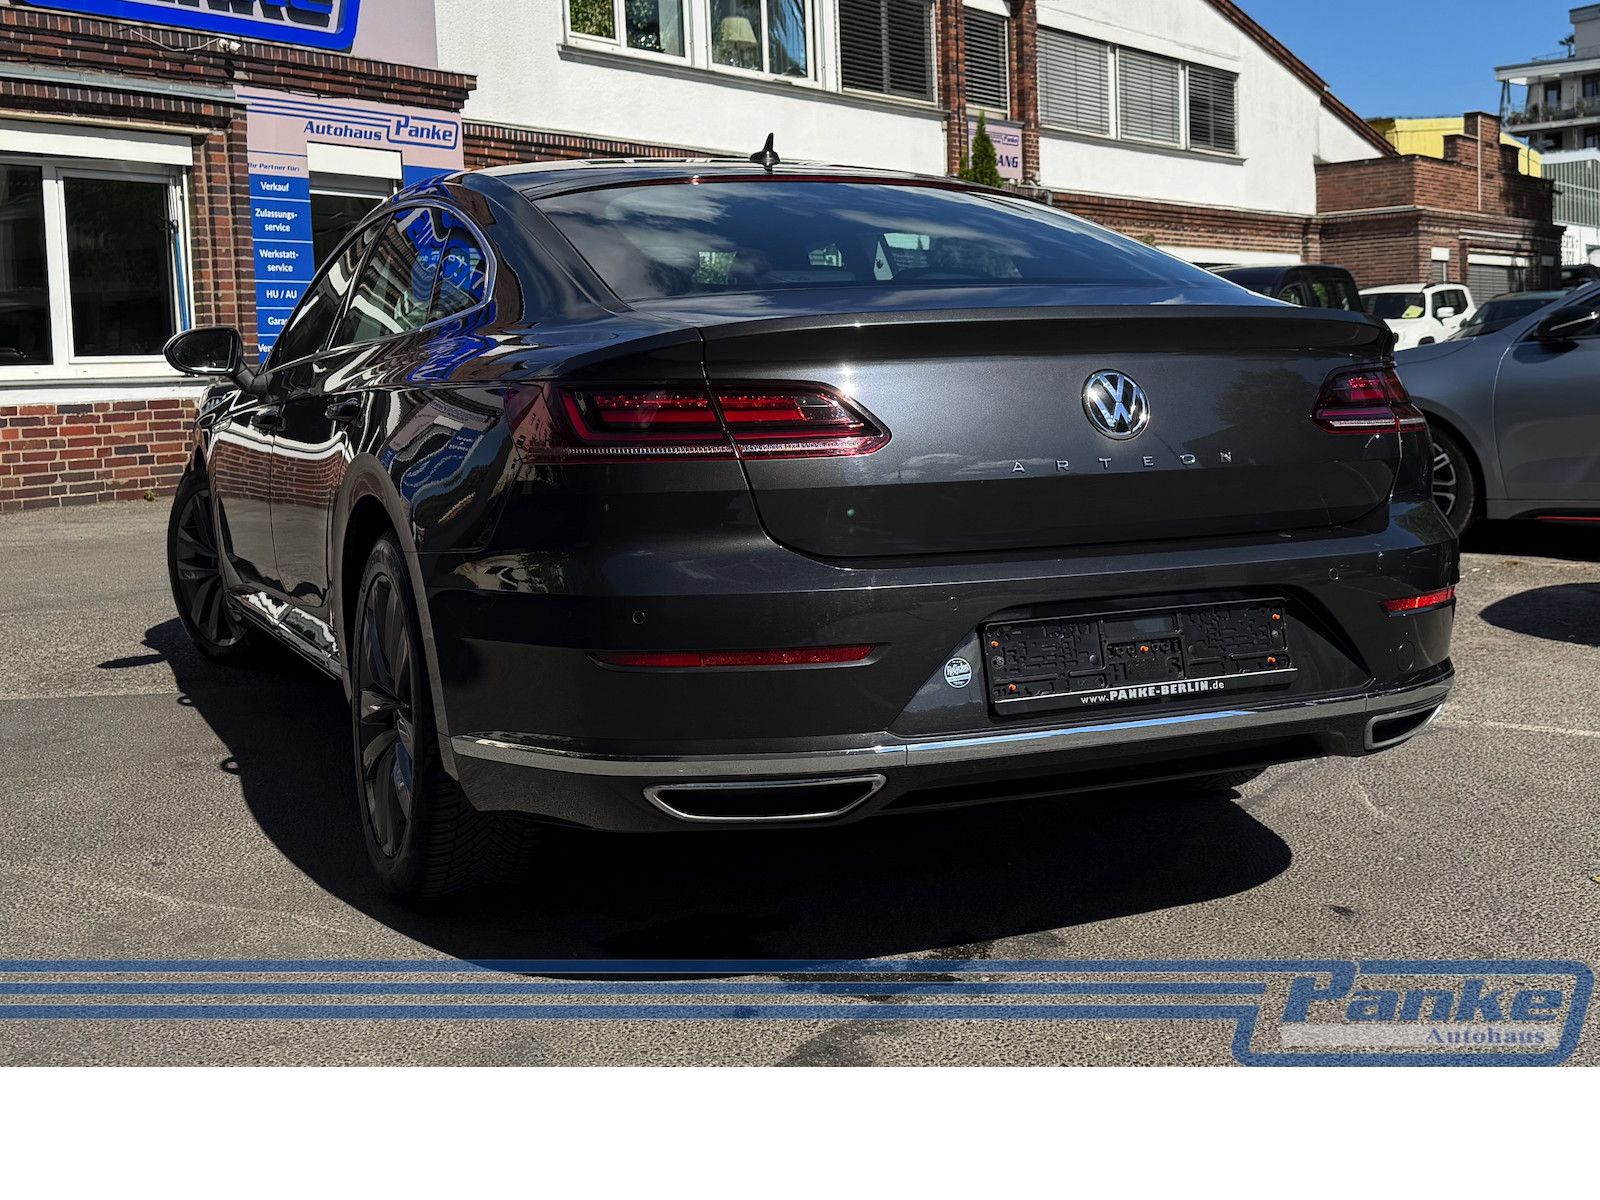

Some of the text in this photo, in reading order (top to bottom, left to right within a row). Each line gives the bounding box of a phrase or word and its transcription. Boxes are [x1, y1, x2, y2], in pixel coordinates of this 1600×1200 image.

[303, 115, 453, 142] Autohaus Panke
[259, 163, 286, 171] Partner
[996, 154, 1019, 169] ANG
[260, 181, 290, 192] Verkauf
[254, 207, 298, 221] Zulassungs-
[264, 222, 291, 233] service
[258, 248, 299, 260] Werkstatt-
[267, 263, 294, 273] service
[266, 289, 279, 299] HU
[285, 289, 298, 299] AU
[257, 343, 273, 353] Ver
[1011, 451, 1234, 474] ARTEON
[1080, 680, 1225, 704] www.PANKE-BERLIN.de
